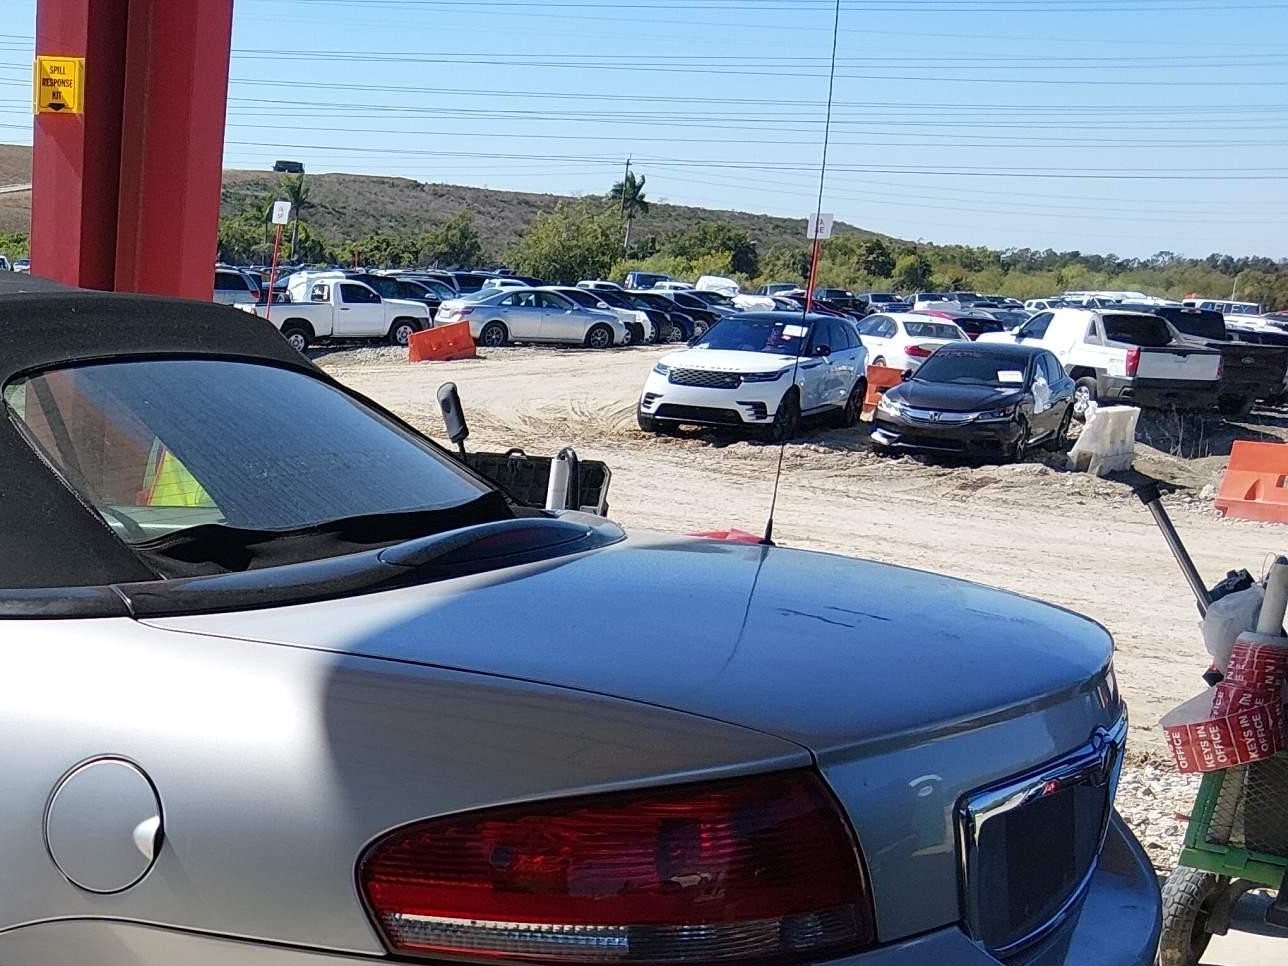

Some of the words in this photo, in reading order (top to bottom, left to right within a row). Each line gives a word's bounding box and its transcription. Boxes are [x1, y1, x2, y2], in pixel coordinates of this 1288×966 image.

[49, 65, 66, 75] SPILL
[42, 77, 73, 88] RESPONSE
[52, 91, 63, 100] KIT
[1238, 715, 1250, 727] IN
[1196, 725, 1207, 738] IN
[1252, 713, 1269, 752] OFFICE
[1172, 731, 1189, 768] OFFICE
[1200, 740, 1216, 768] KEYS
[1209, 725, 1227, 763] OFFICE
[1242, 730, 1259, 759] KEYS
